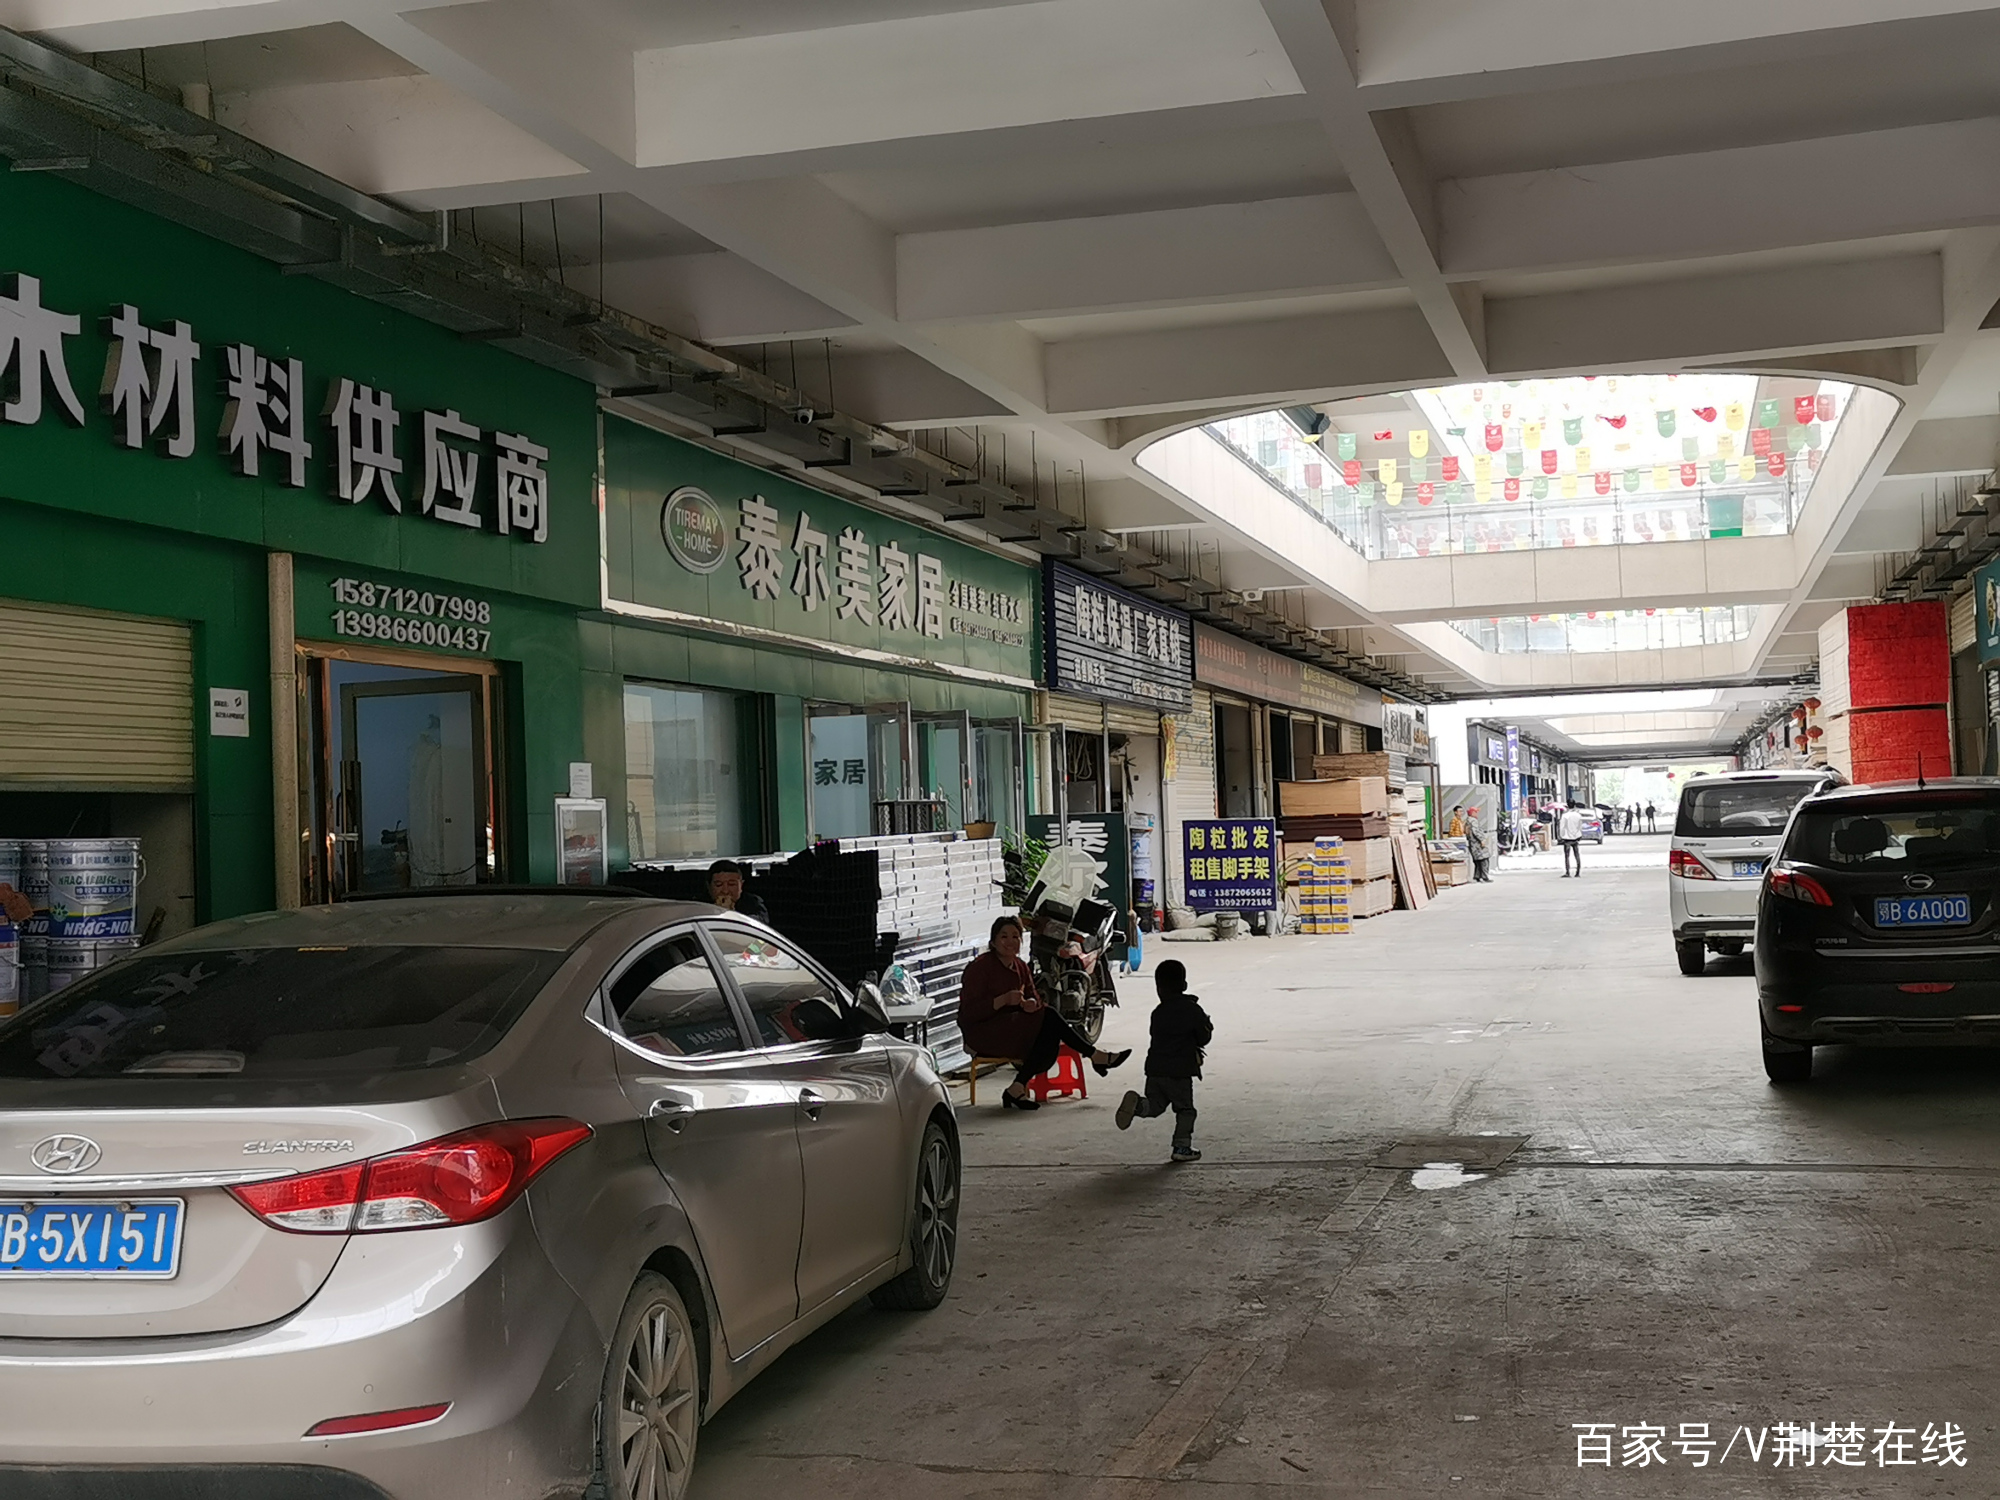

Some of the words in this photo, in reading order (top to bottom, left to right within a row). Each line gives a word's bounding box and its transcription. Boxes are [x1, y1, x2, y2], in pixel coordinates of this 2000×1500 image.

[675, 507, 718, 535] TIREMAY
[737, 494, 946, 641] 泰尔美家居
[331, 578, 491, 624] 15871207998
[331, 610, 491, 652] 13986600437
[1075, 584, 1181, 668] 陶粒保温厂家直销
[814, 759, 867, 786] 家居
[1189, 825, 1270, 851] 陶粒批发
[1190, 856, 1270, 881] 租售脚手架
[243, 1139, 355, 1155] ELANTRA
[0, 1212, 167, 1263] B·5X151
